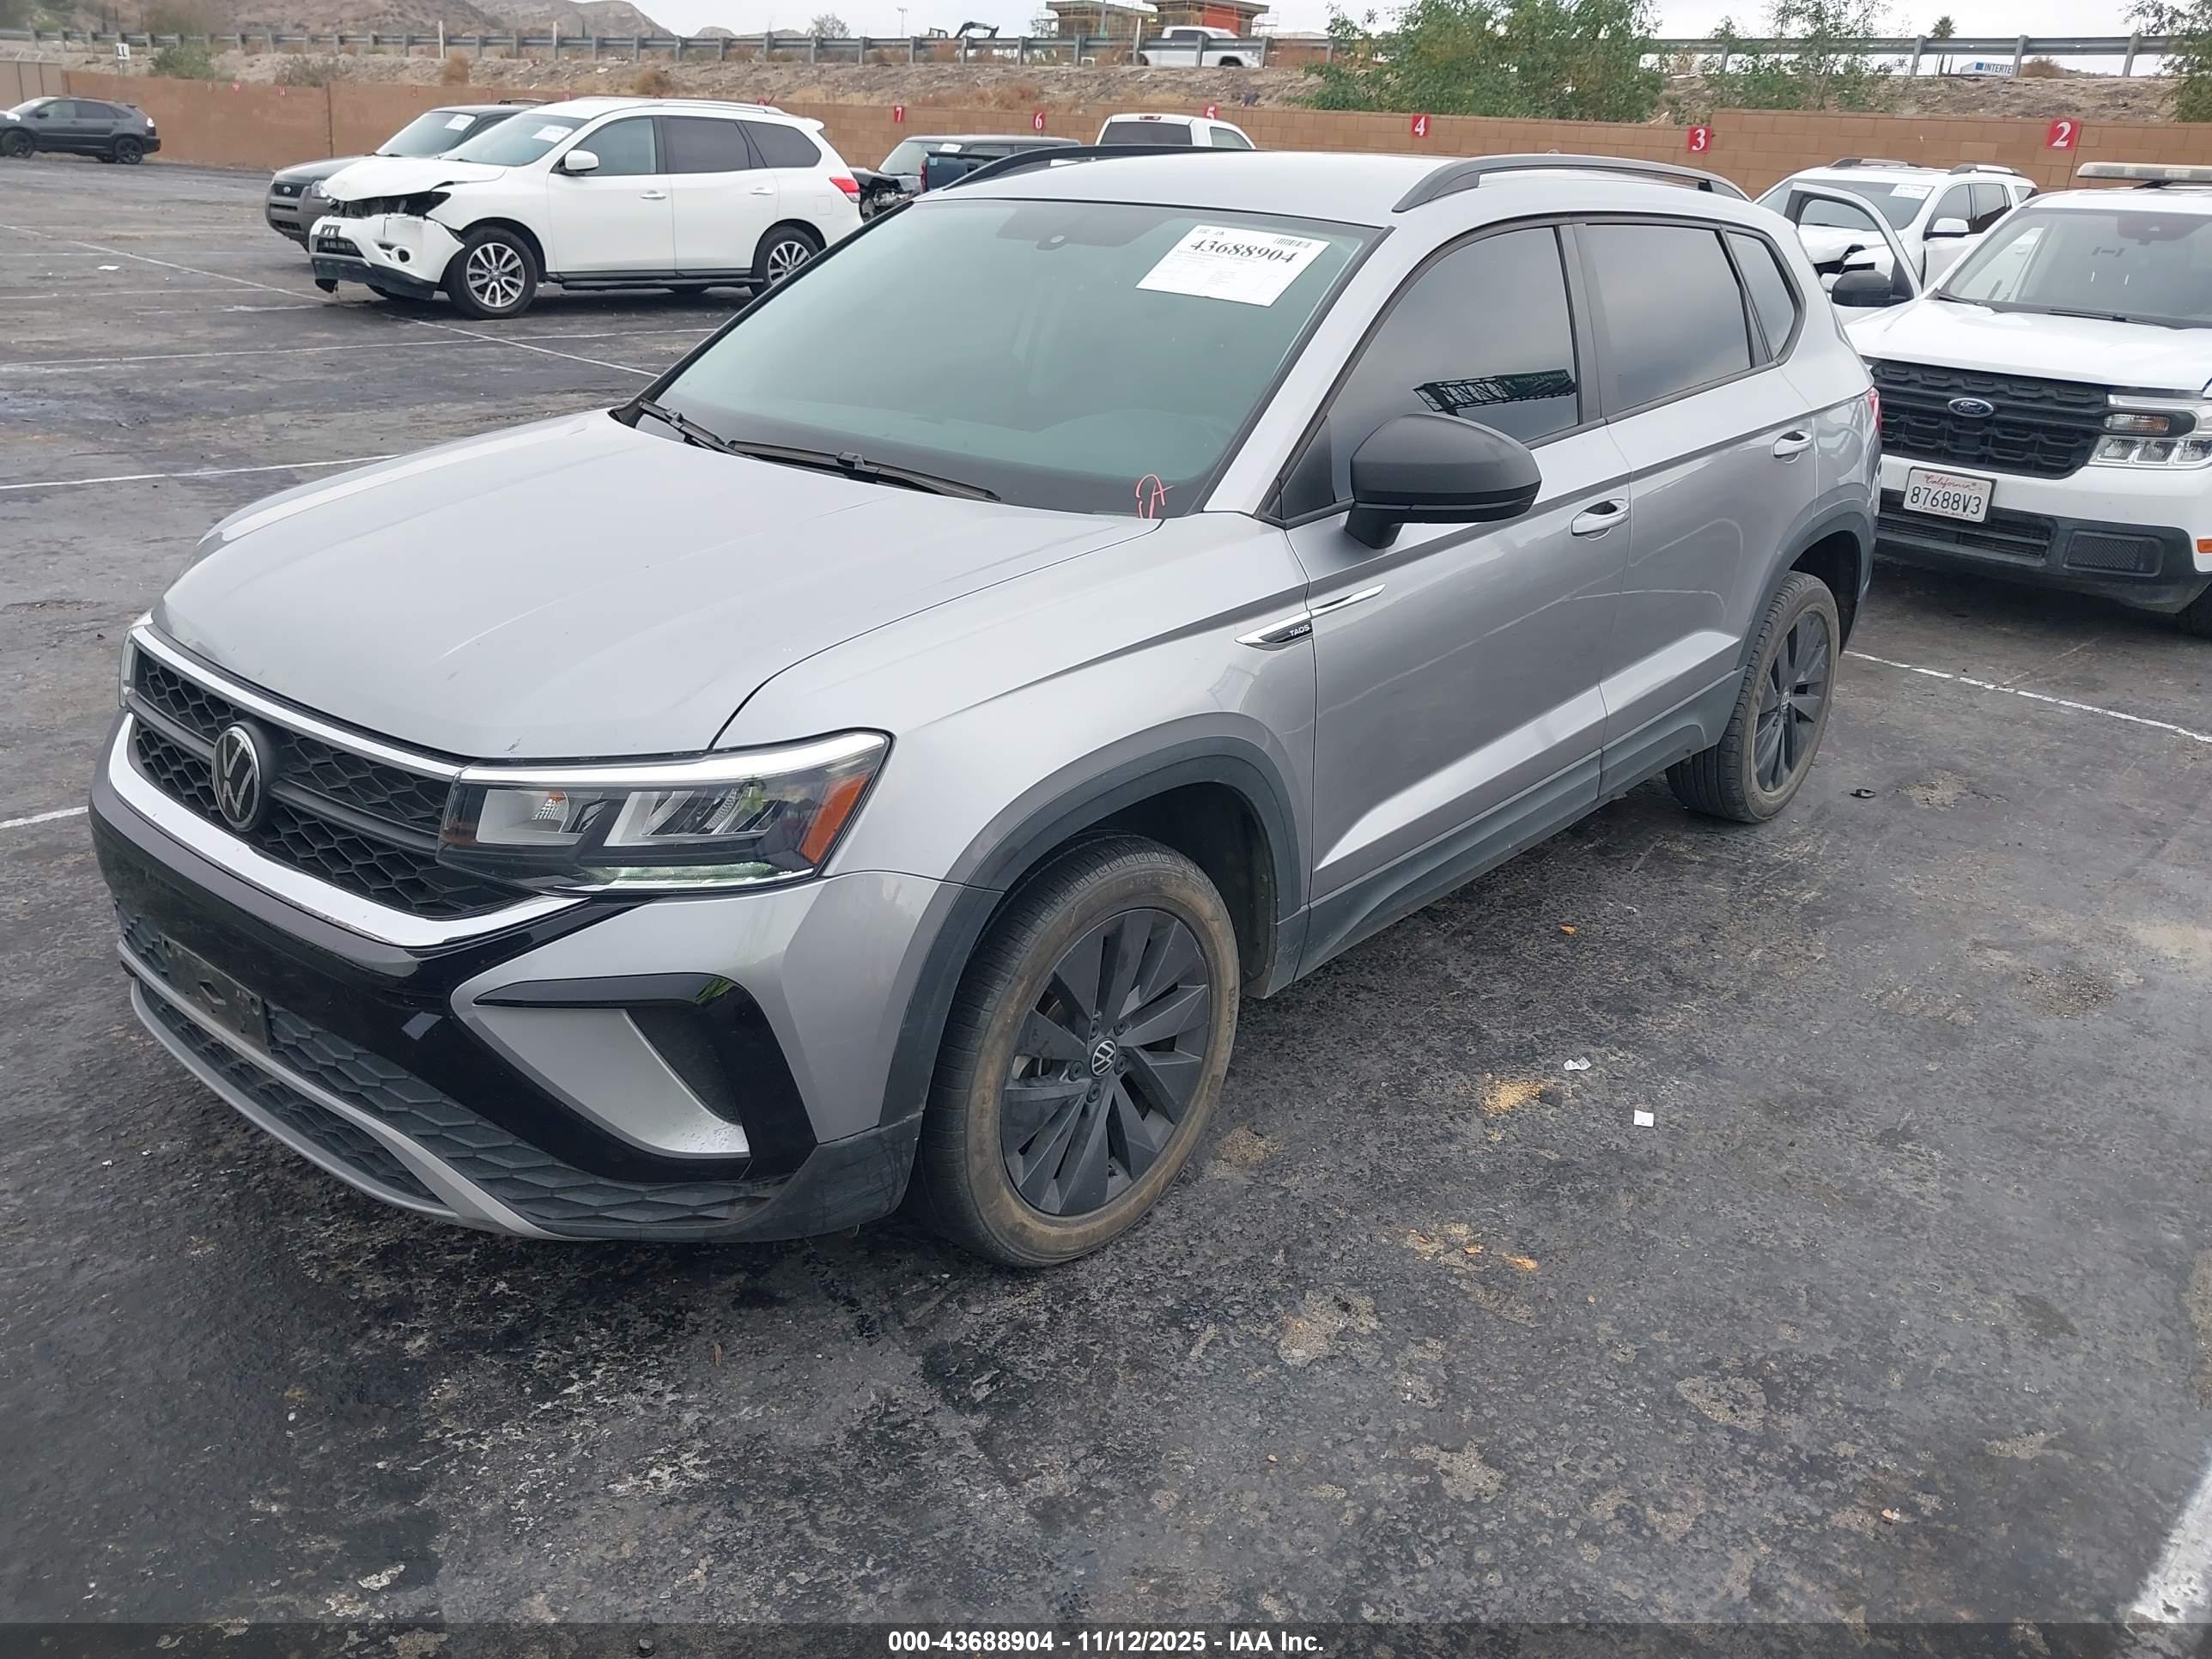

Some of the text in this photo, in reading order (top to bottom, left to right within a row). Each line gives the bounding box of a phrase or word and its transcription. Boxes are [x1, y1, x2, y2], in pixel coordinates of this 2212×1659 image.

[896, 106, 902, 122] 7
[1035, 112, 1043, 130] 6
[1206, 106, 1216, 120] 5
[1414, 116, 1425, 137] 4
[2051, 121, 2071, 147] 2
[1691, 128, 1706, 151] 3
[1190, 239, 1299, 264] 43688904
[1923, 473, 1973, 490] California
[1910, 485, 1982, 515] 87688V3
[1289, 623, 1311, 637] TAOS
